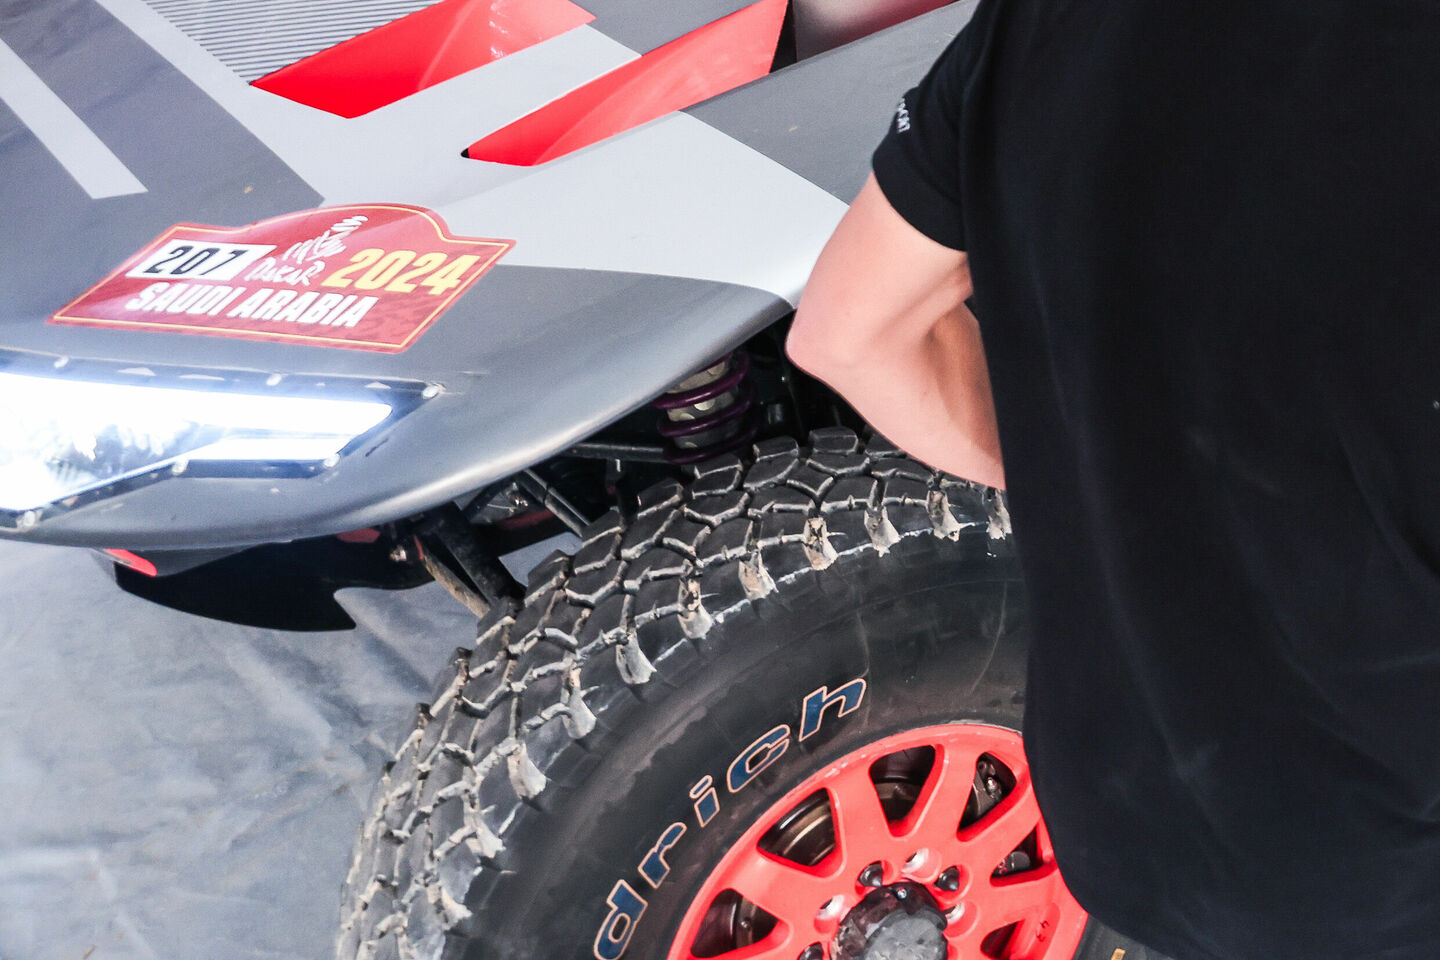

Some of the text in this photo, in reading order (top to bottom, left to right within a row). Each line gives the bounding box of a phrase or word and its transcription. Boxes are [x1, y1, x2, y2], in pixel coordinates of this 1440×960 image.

[143, 245, 248, 276] 207
[321, 248, 481, 296] 2024
[125, 282, 380, 329] SAUDI ARABIA
[593, 677, 867, 960] drich
